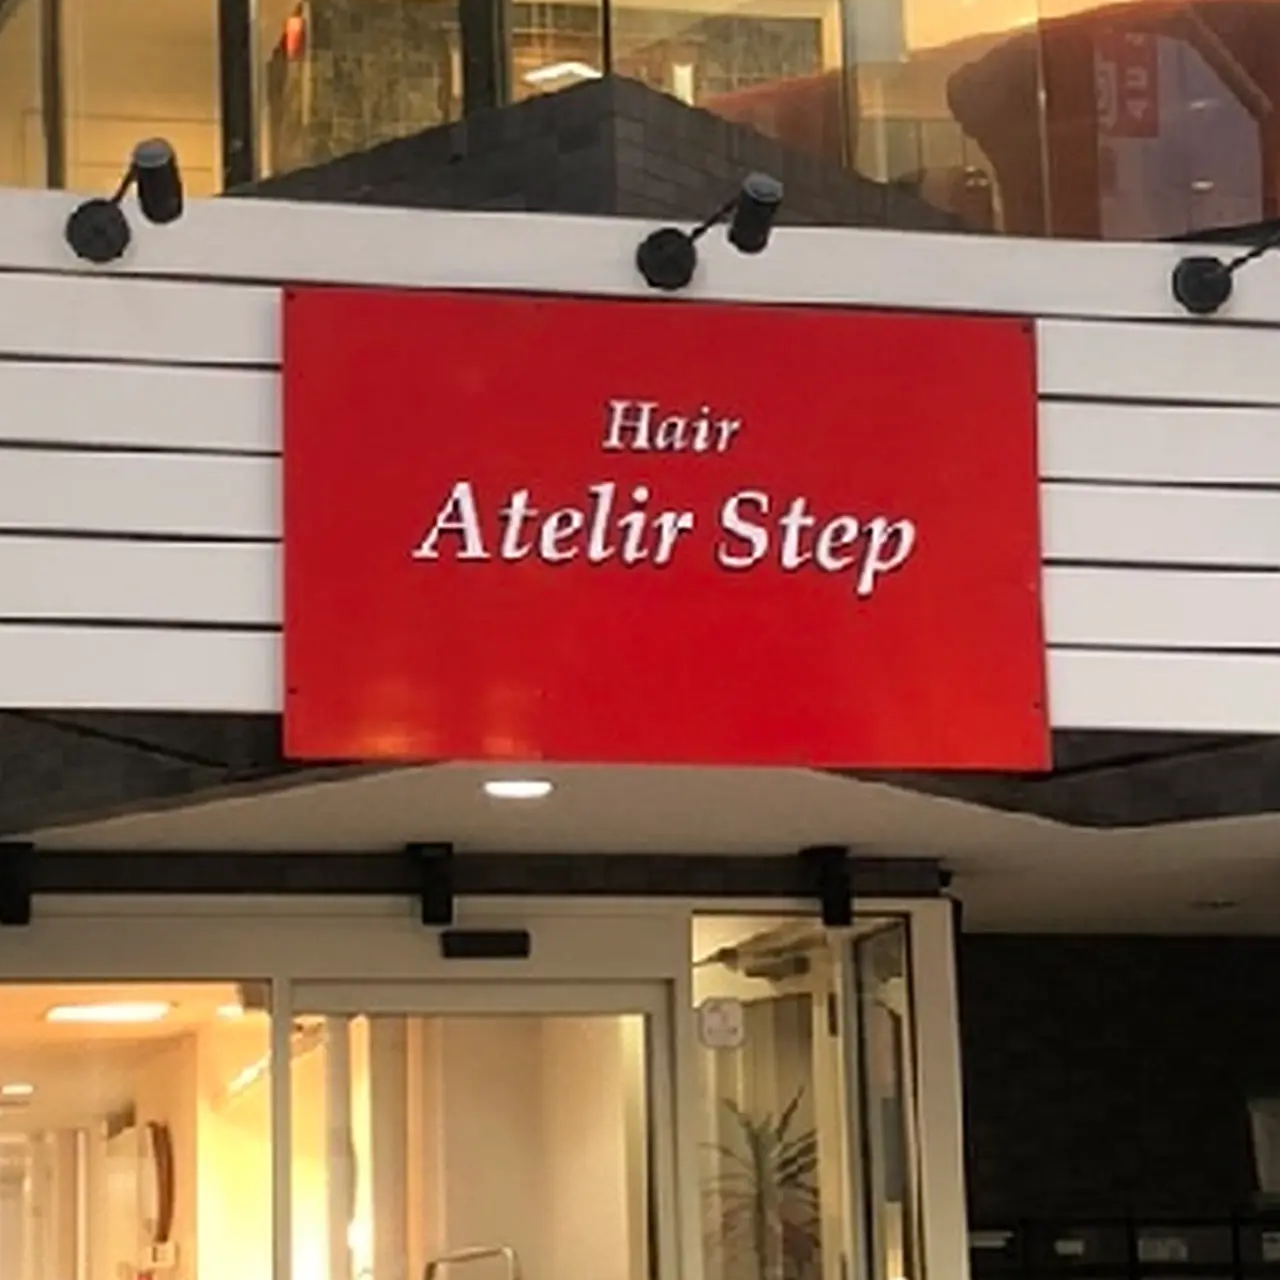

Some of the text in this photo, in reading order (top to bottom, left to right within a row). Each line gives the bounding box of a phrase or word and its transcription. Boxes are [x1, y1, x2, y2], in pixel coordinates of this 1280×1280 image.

[602, 400, 741, 452] Hair
[413, 482, 917, 596] Atelir Step
